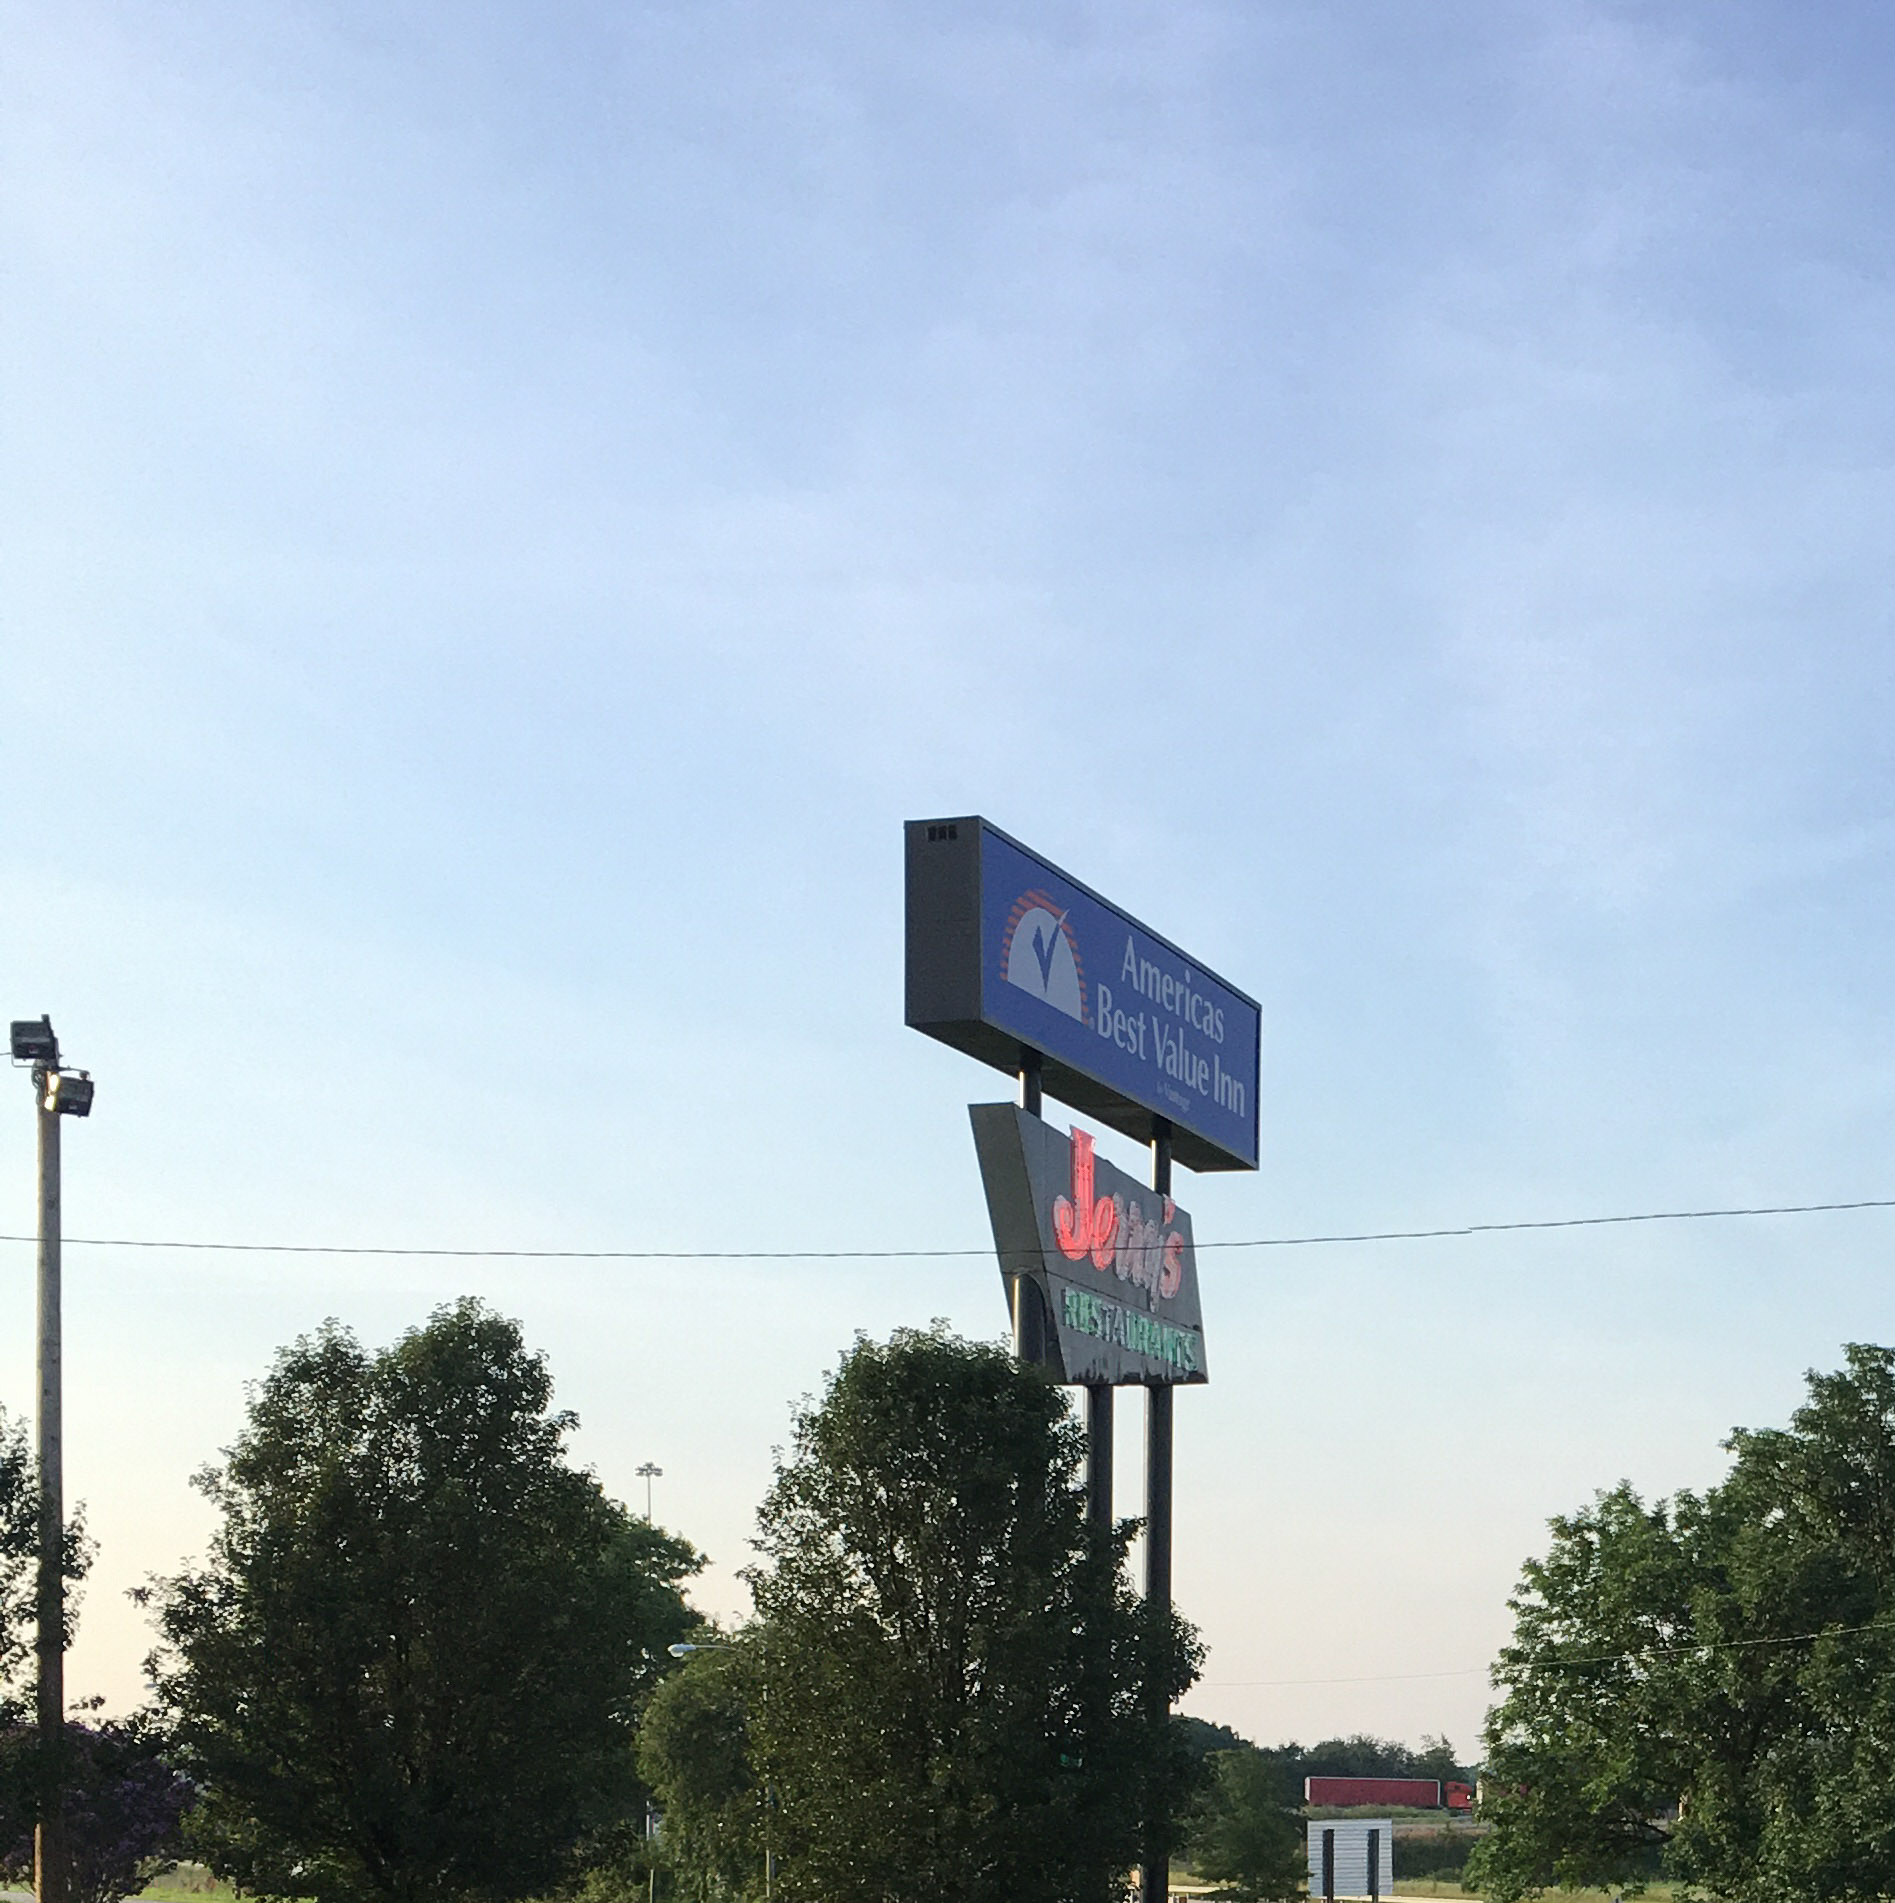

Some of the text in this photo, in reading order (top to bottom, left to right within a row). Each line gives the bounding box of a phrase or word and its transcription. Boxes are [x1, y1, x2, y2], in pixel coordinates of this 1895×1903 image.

[1098, 983, 1146, 1061] Best
[1152, 1015, 1209, 1096] Value
[1214, 1053, 1245, 1118] Inn
[1122, 935, 1224, 1044] Americas
